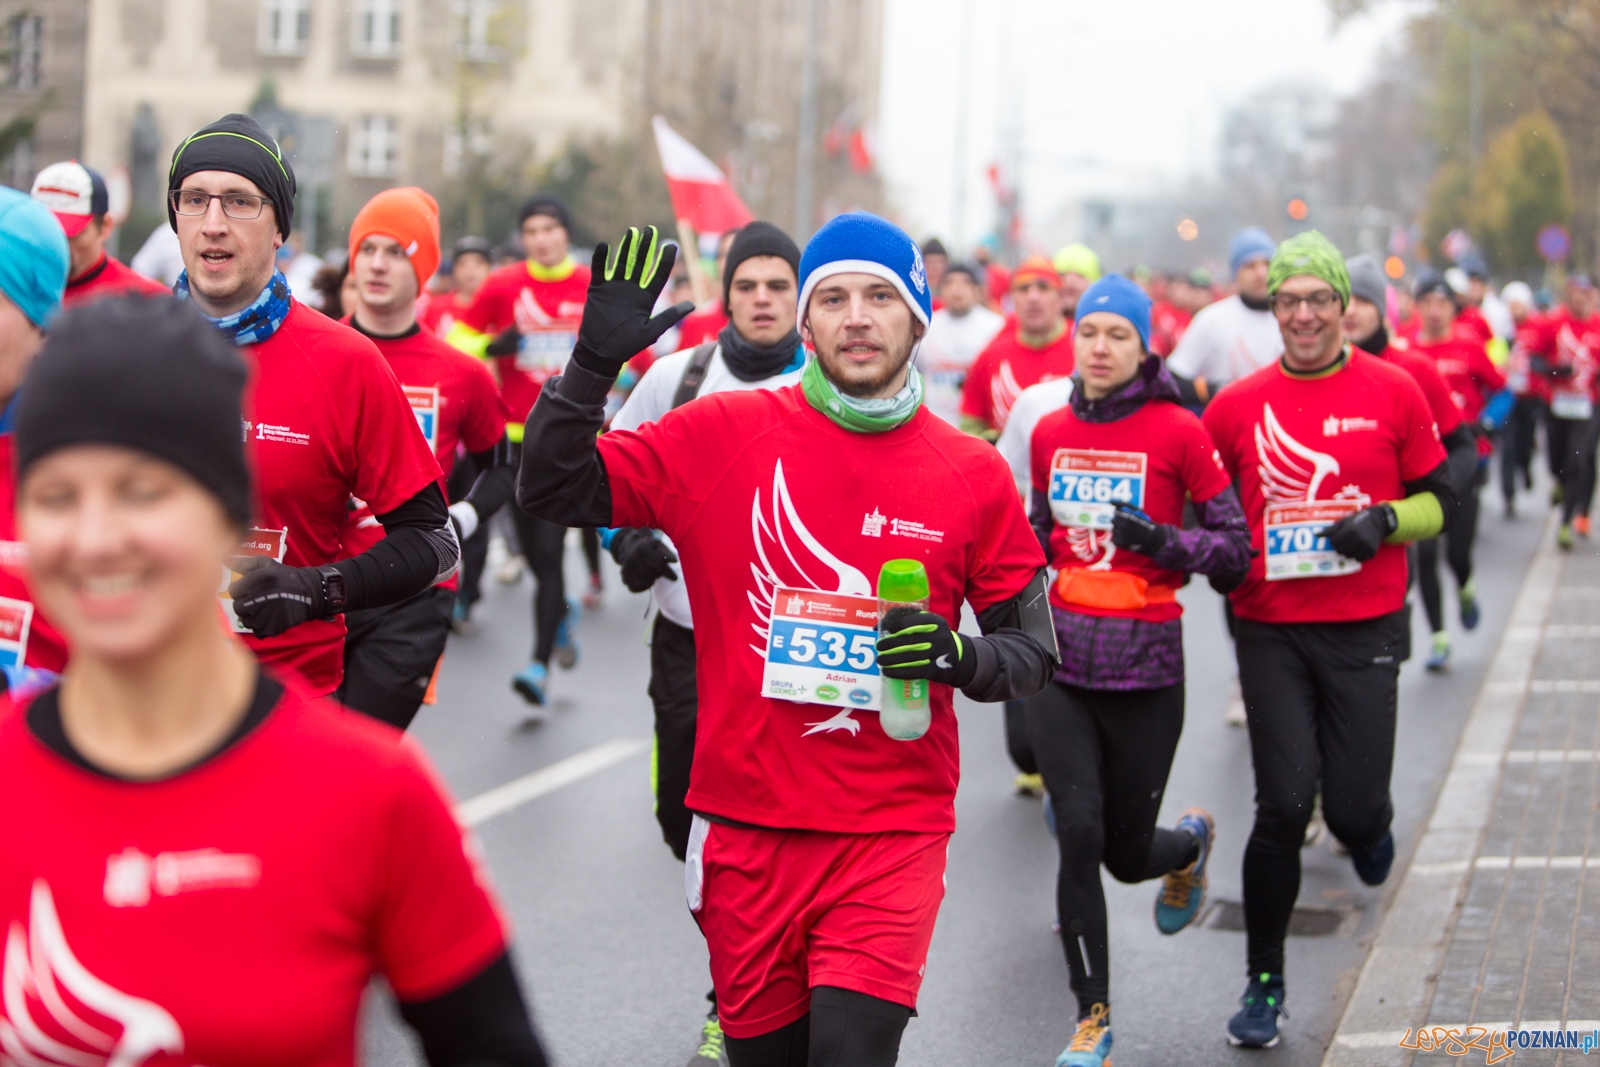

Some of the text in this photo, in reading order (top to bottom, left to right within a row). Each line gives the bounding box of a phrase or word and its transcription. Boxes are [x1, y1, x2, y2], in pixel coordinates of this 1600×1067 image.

[1061, 475, 1133, 503] 7664
[772, 627, 877, 670] E 535
[826, 673, 857, 684] Adrian
[771, 680, 793, 689] GRUPA
[770, 687, 797, 696] LUXMED
